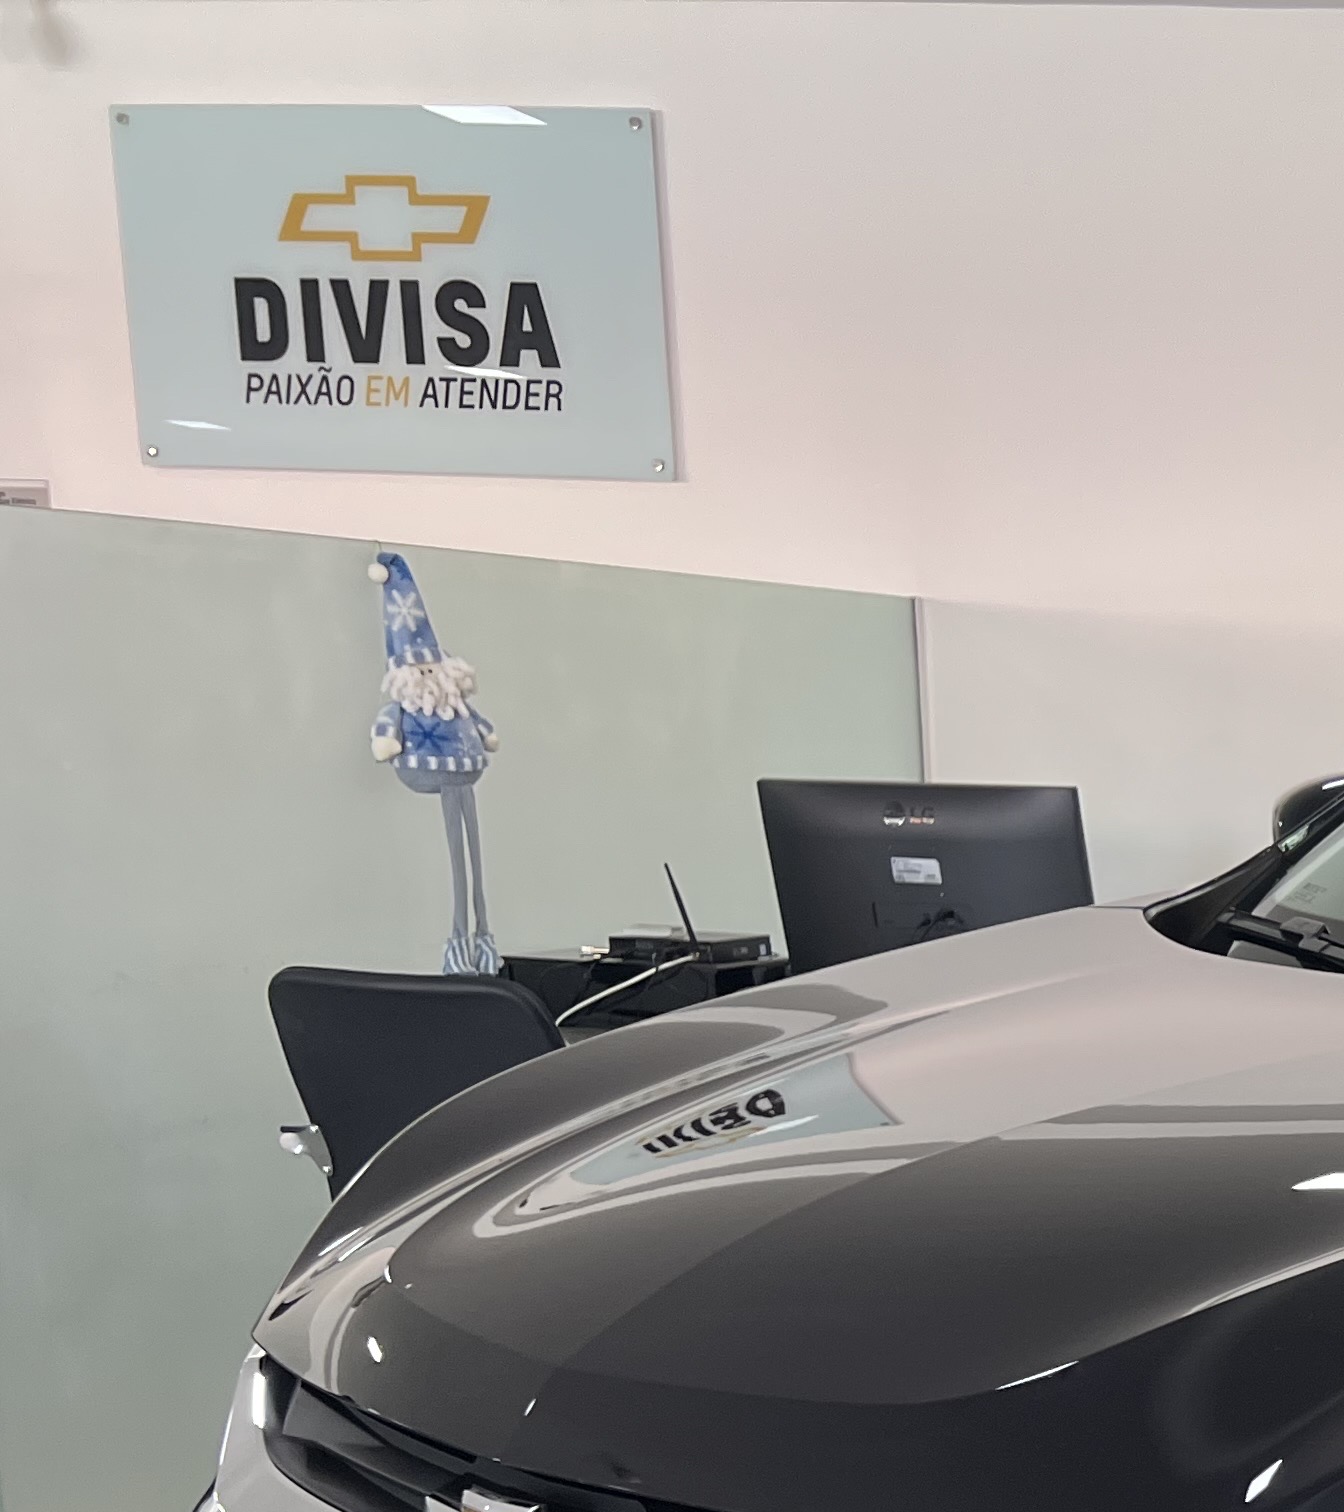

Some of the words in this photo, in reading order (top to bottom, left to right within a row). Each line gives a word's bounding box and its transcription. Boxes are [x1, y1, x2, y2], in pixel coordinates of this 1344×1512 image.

[233, 277, 562, 369] DIVISA
[245, 367, 355, 406] PAIXÃO
[365, 375, 410, 408] EM
[419, 377, 563, 412] ATENDER
[909, 806, 935, 825] LG
